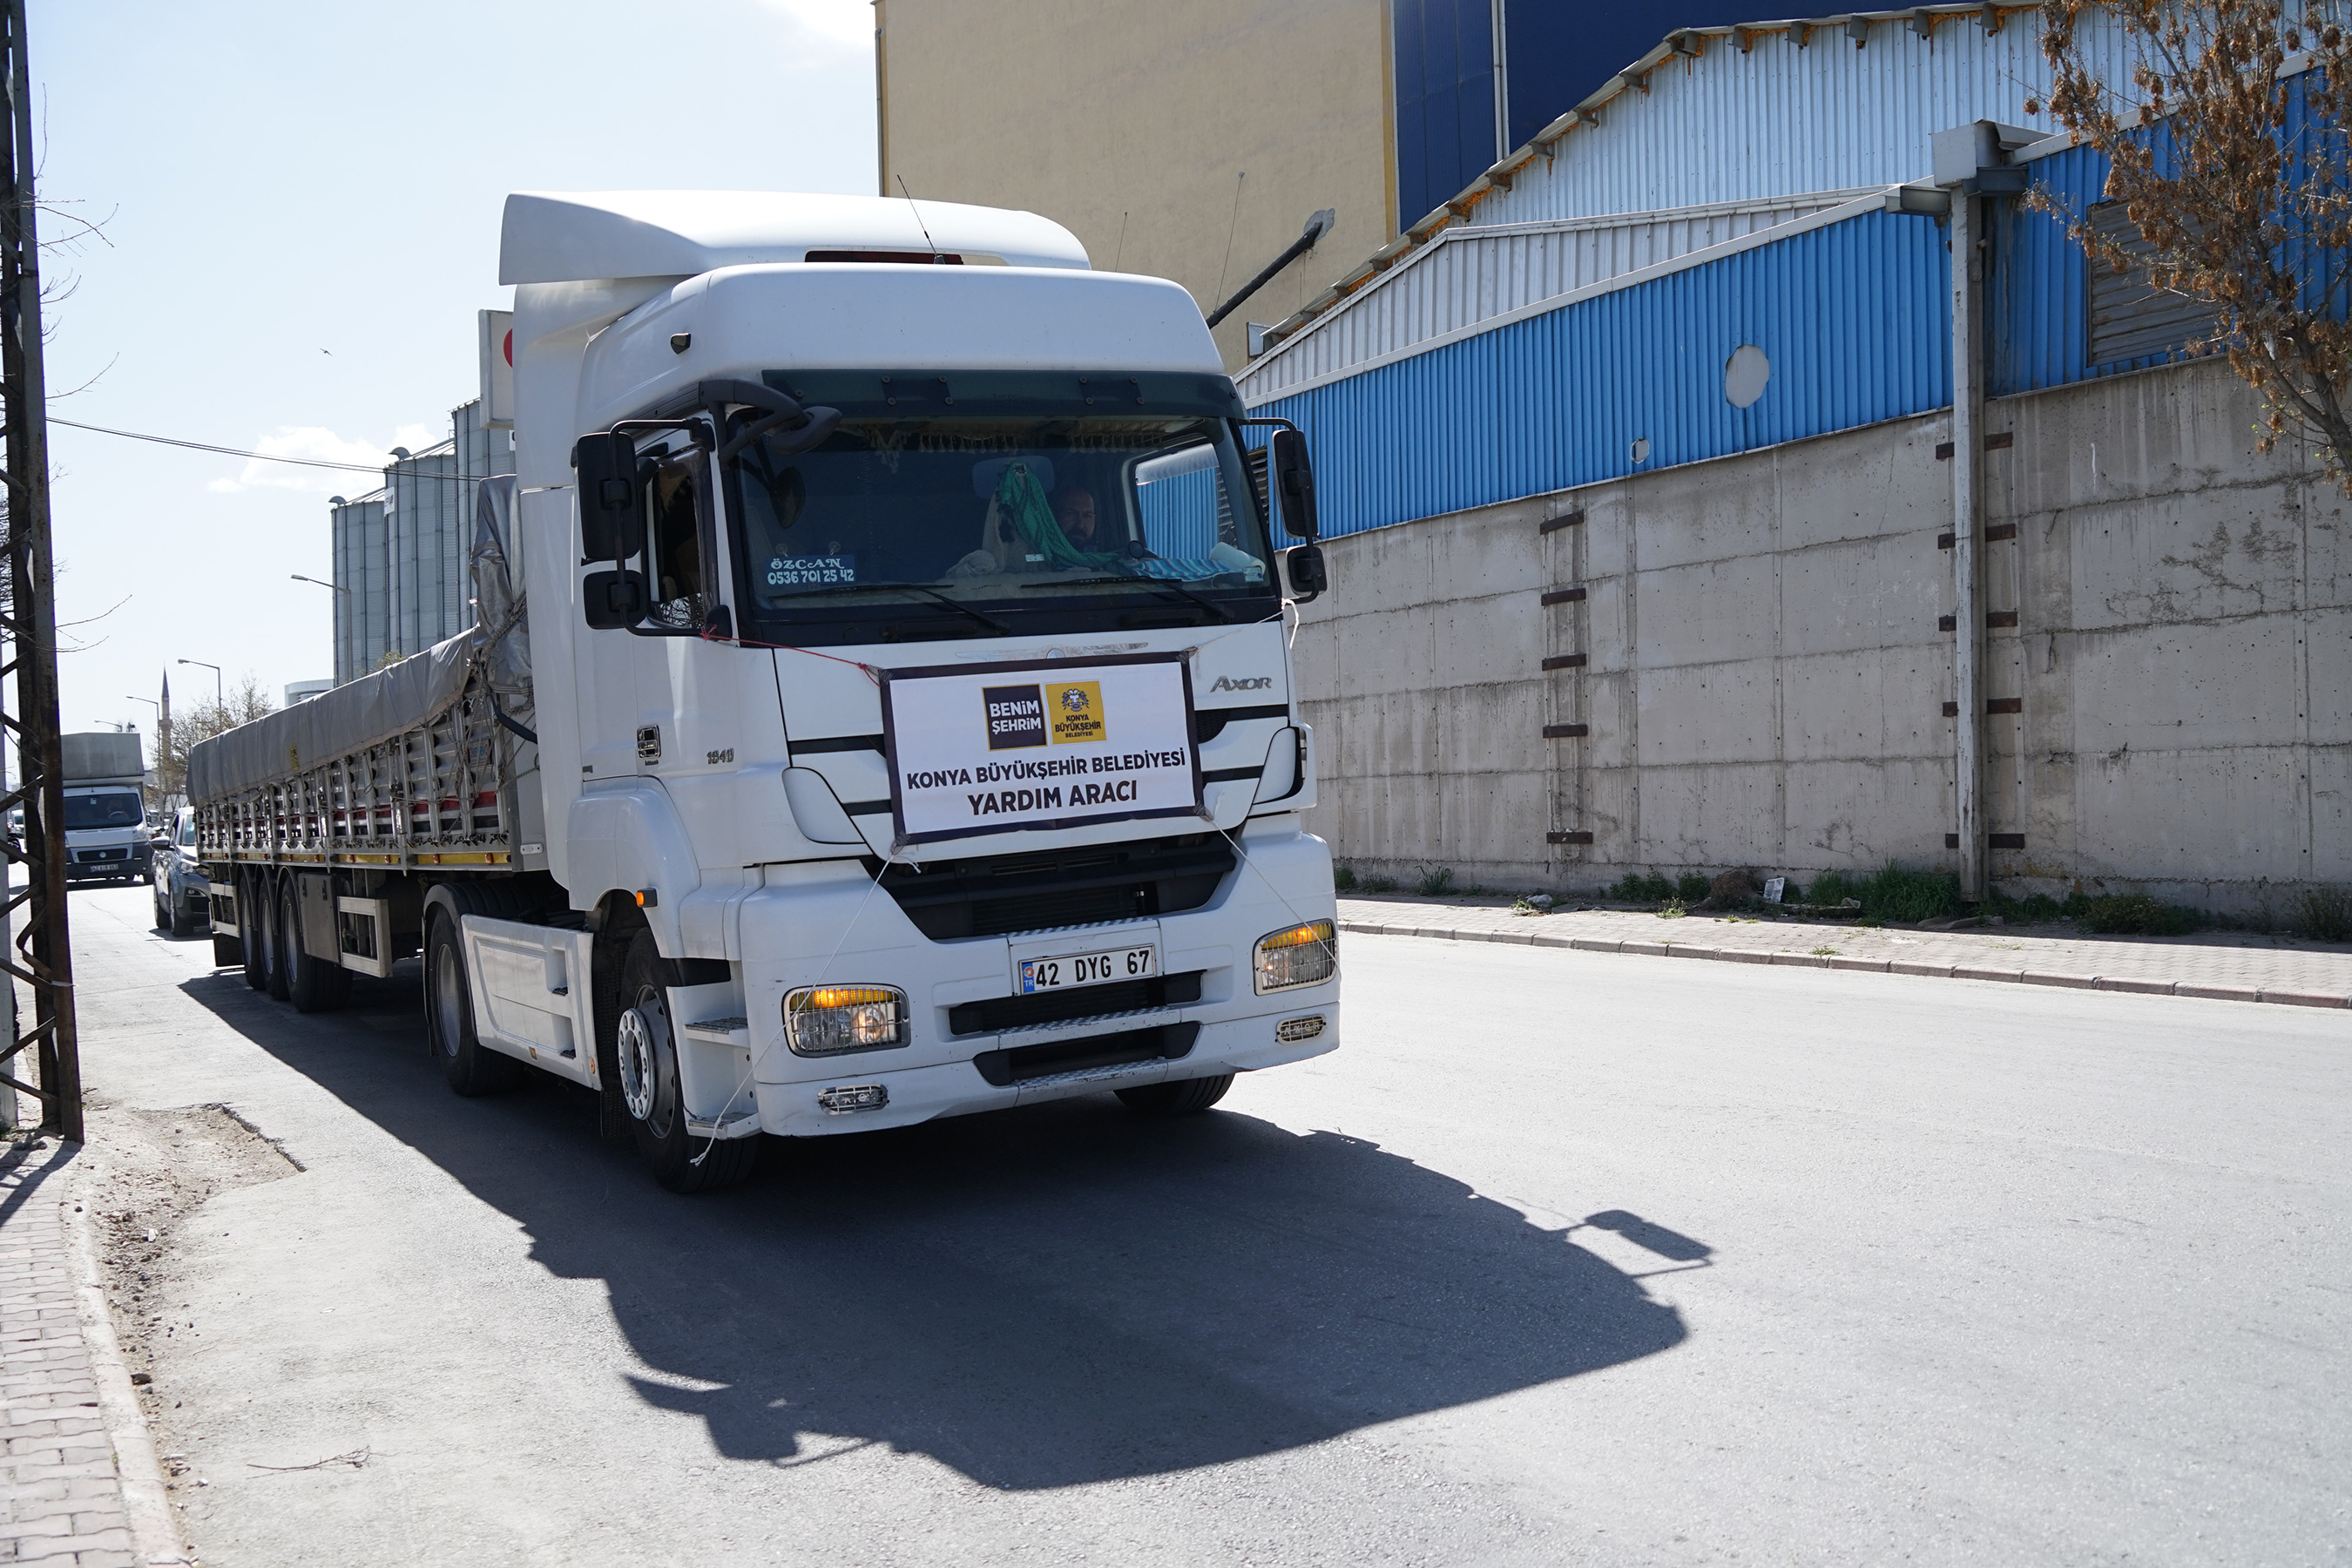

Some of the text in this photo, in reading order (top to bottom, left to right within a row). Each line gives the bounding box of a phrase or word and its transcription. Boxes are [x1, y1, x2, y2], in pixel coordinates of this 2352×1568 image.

[770, 558, 845, 570] ÖZCAN
[767, 569, 854, 585] 0536 701 25 42
[1065, 713, 1090, 722] KONYA
[1055, 720, 1102, 733] BÜYÜKŞEHİR
[907, 747, 1186, 790] KONYA BÜYÜKŞEHİR BELEDİYESİ
[967, 780, 1137, 816] YARDIM ARACI
[1036, 950, 1150, 987] 42 DYG 67
